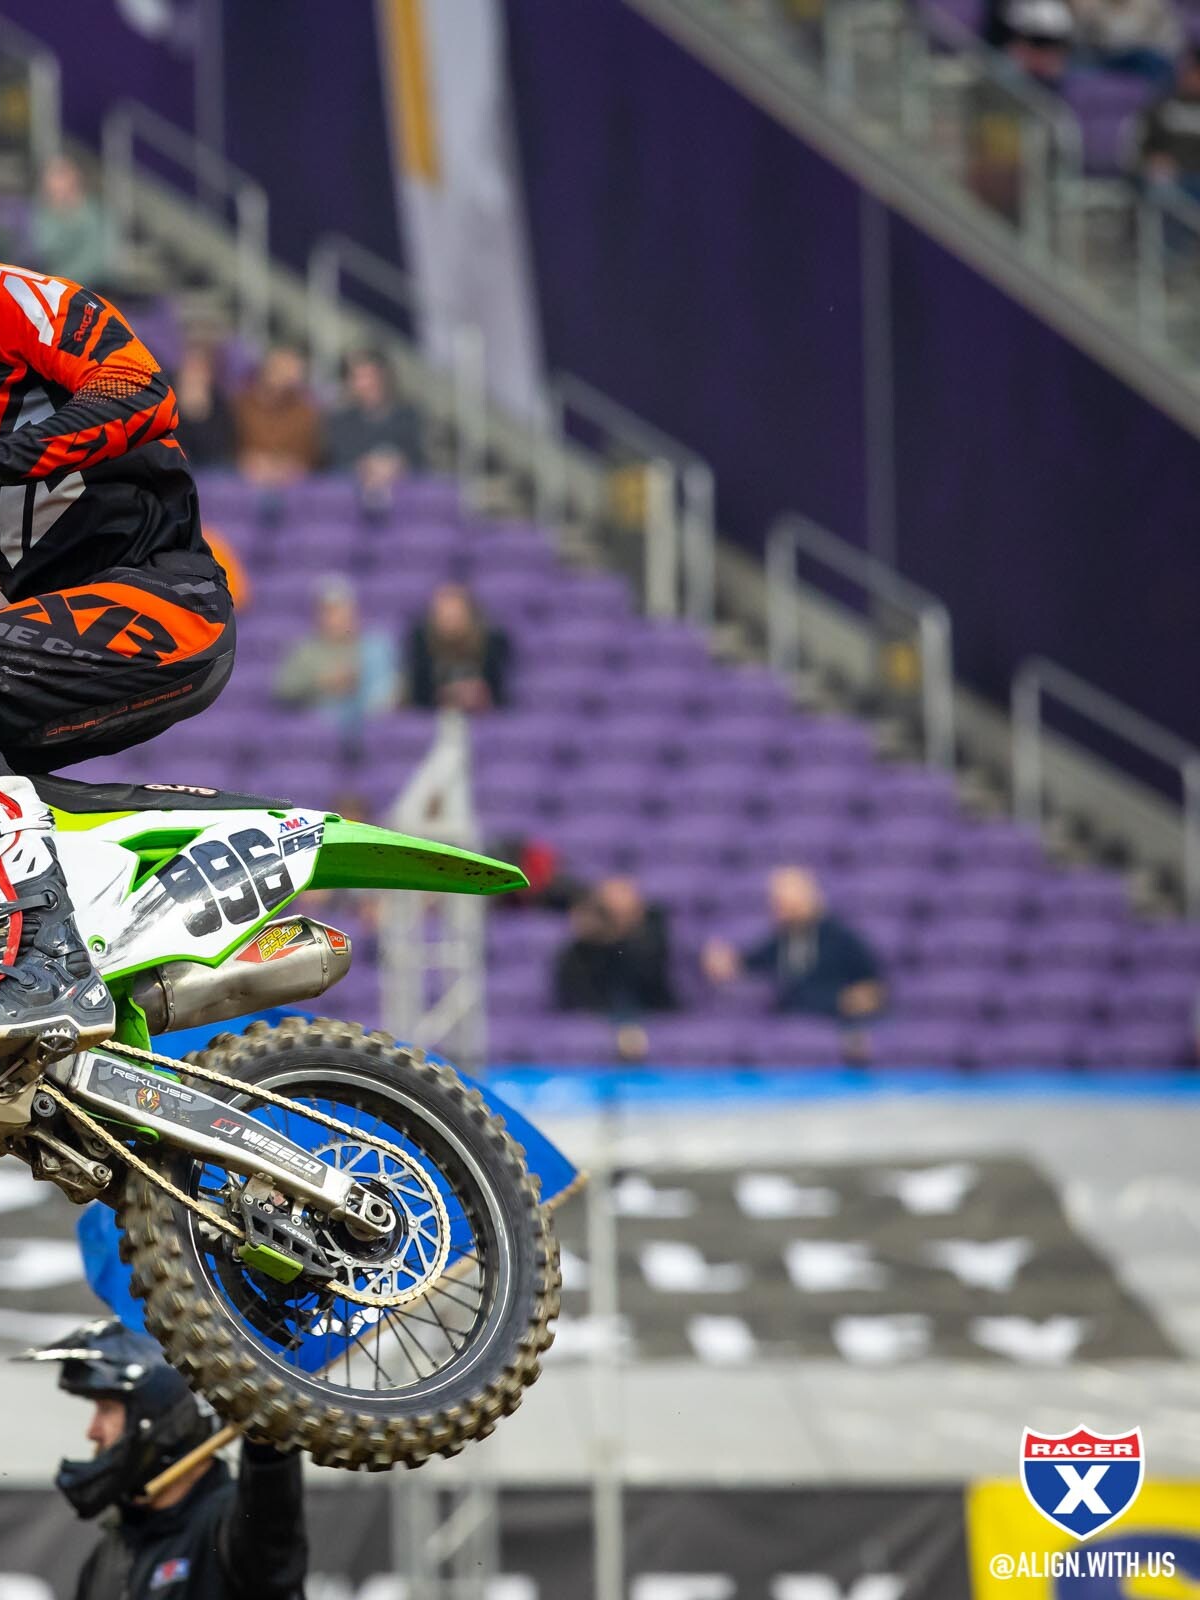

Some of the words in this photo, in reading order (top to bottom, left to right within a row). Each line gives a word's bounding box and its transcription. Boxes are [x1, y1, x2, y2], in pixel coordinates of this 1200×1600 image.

[279, 816, 309, 834] AMA
[155, 828, 295, 938] 996
[257, 926, 282, 950] PRO
[262, 923, 302, 960] CIRCUIT
[112, 1067, 193, 1102] REKLUSE
